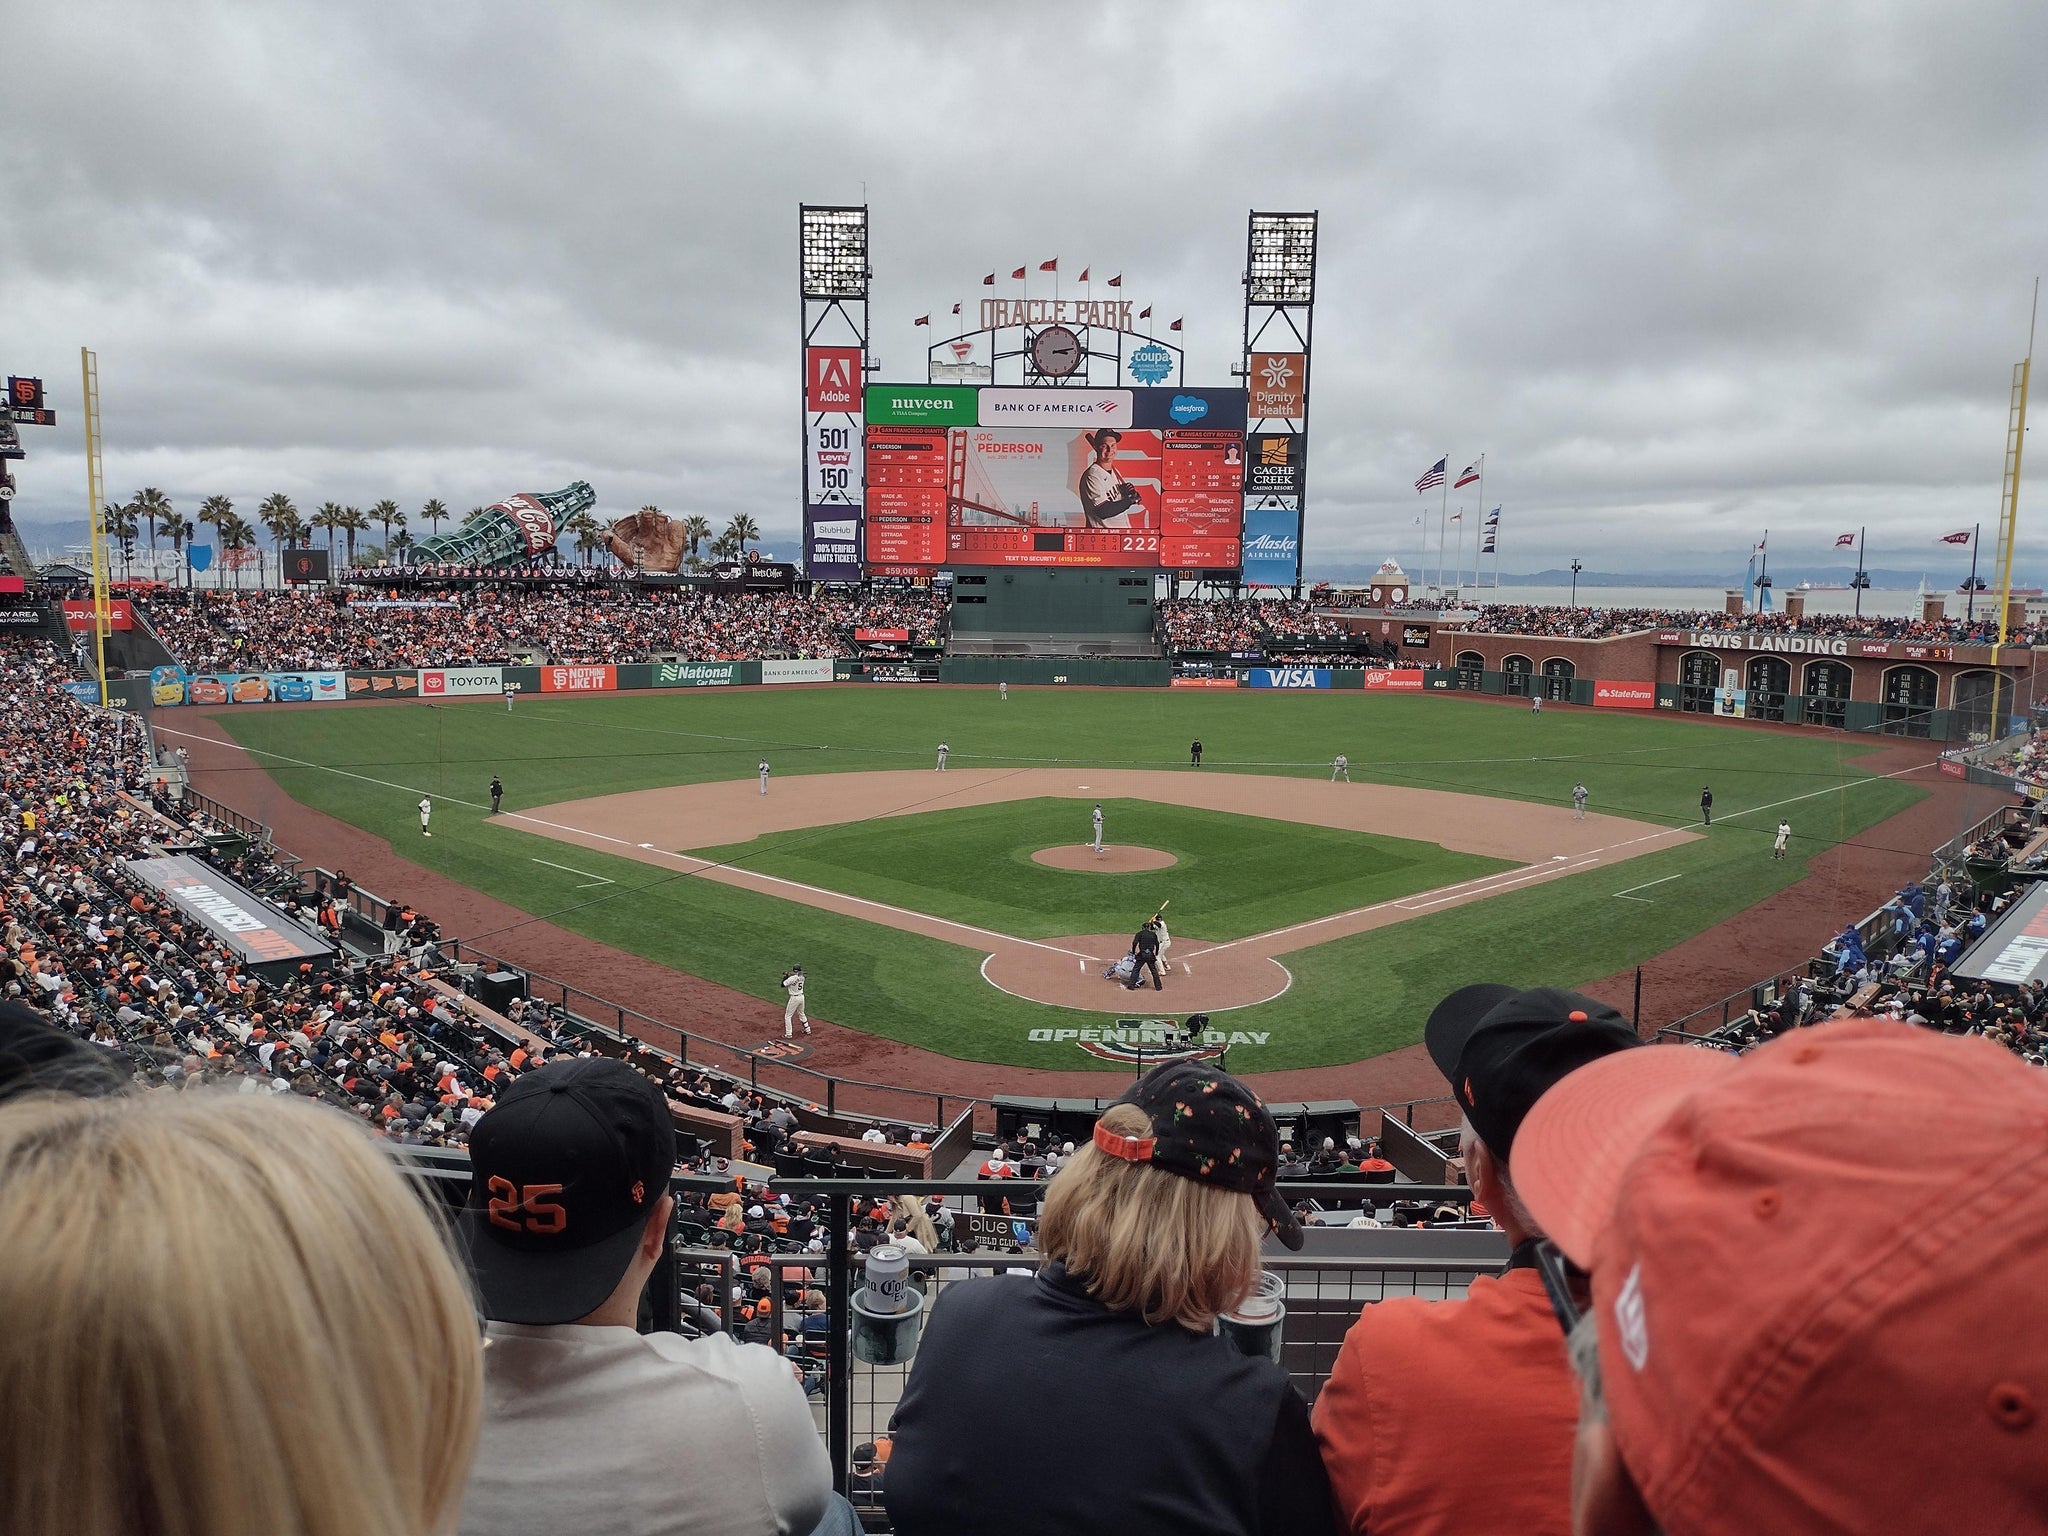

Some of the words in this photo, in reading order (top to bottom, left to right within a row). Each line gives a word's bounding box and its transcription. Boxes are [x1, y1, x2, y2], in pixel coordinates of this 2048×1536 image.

[980, 299, 1066, 332] ORACLE
[1075, 301, 1133, 334] PARK
[1135, 352, 1169, 365] coupa
[819, 391, 850, 402] Adobe
[1256, 391, 1295, 404] Dignity
[891, 398, 954, 409] nuveen
[994, 404, 1025, 412] BANK
[1027, 404, 1041, 412] OF
[1044, 404, 1094, 413] AMERICA
[1174, 405, 1205, 413] salesforce
[21, 411, 35, 421] ARE
[820, 428, 848, 449] 501
[974, 433, 993, 441] JOC
[978, 443, 1043, 453] PEDERSON
[1253, 466, 1295, 475] CACHE
[1253, 475, 1293, 484] CREEK
[819, 526, 851, 534] StubHub
[1245, 535, 1297, 550] Alaska
[815, 544, 830, 553] 100%
[831, 544, 856, 553] VERIFIED
[813, 554, 833, 562] GIANTS
[834, 554, 857, 563] TICKETS
[752, 567, 766, 577] Peet's
[766, 567, 782, 578] Coffee
[65, 611, 123, 619] ORALE
[1412, 630, 1429, 639] Sports
[1748, 636, 1847, 655] LANDING
[678, 665, 733, 679] National
[449, 676, 498, 687] TOYOTA
[553, 668, 568, 689] SF
[569, 668, 606, 678] NOTHING
[569, 678, 591, 689] LIKE
[592, 676, 606, 689] IT
[1054, 675, 1067, 683] 391
[1265, 670, 1316, 687] VISA
[503, 682, 522, 690] 354
[1434, 680, 1447, 688] 415
[67, 685, 97, 695] Alaska
[1610, 690, 1630, 698] State
[1630, 691, 1651, 699] Farm
[107, 698, 127, 708] 339
[1660, 699, 1673, 707] 365
[1968, 732, 1989, 742] 309
[1942, 764, 1961, 775] ORACLE
[797, 982, 803, 990] 5
[1203, 1030, 1271, 1045] DAY
[488, 1175, 567, 1233] 25
[969, 1215, 1008, 1234] blue
[974, 1236, 997, 1246] FIELD
